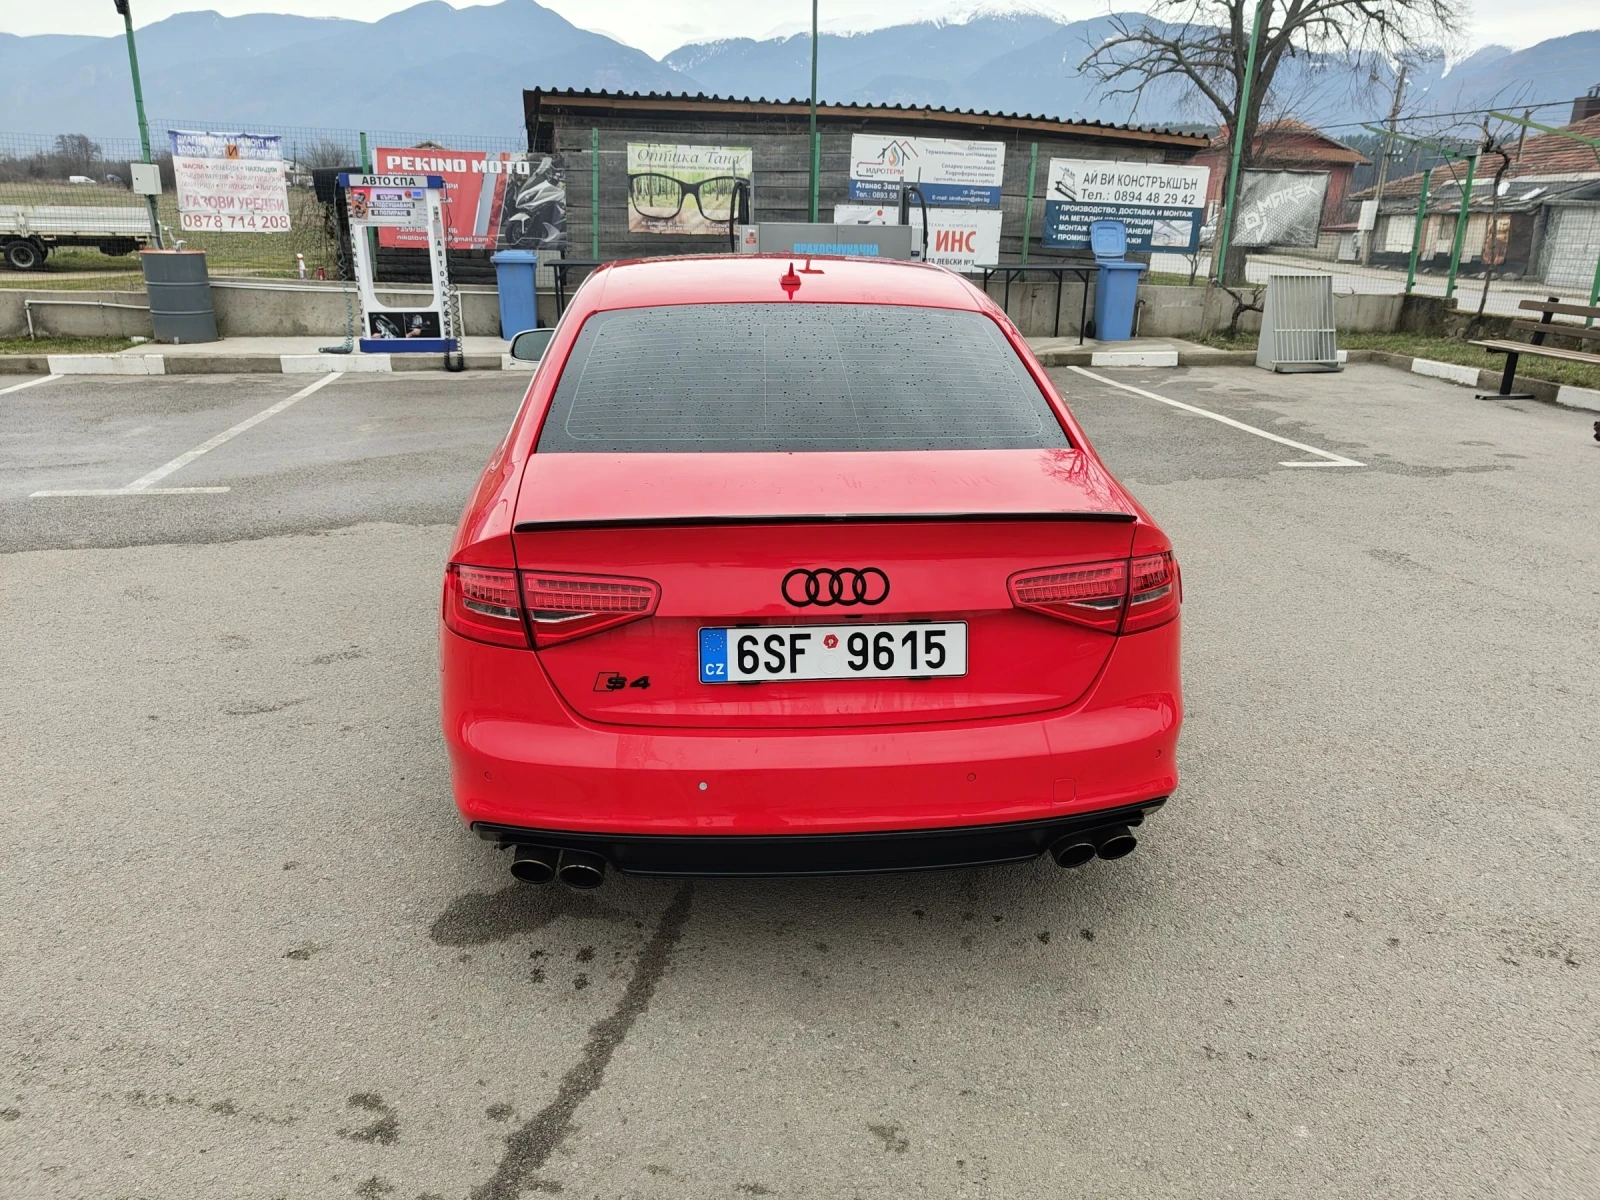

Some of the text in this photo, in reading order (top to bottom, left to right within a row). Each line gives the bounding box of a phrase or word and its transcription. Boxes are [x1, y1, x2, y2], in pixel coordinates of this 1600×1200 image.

[177, 135, 229, 146] ДИАГНОТИКА
[177, 145, 207, 154] ХОДОВА
[637, 148, 699, 164] Оптика
[386, 155, 530, 175] PEKINO MOTO
[361, 175, 416, 187] АВТО СПА
[855, 181, 882, 189] Атанас
[1082, 170, 1098, 185] АЙ
[1100, 173, 1115, 185] ВИ
[1117, 175, 1198, 190] КОНСТРЪКШЪН
[185, 194, 285, 213] ГАЗОВИ УРЕДБИ
[1081, 188, 1196, 206] Тел.: 0894 48 29 42
[1059, 214, 1070, 222] НА
[1061, 204, 1194, 218] ПРОИЗВОДСТВО, ДОСТАВКА И МОНТАЖ
[183, 214, 289, 229] 0878 714 208
[1058, 224, 1088, 232] МОНТАЖ
[935, 230, 977, 253] ИНС
[936, 258, 962, 266] ЛЕВСКИ
[736, 630, 947, 676] 6SF 9615
[705, 663, 725, 676] CZ
